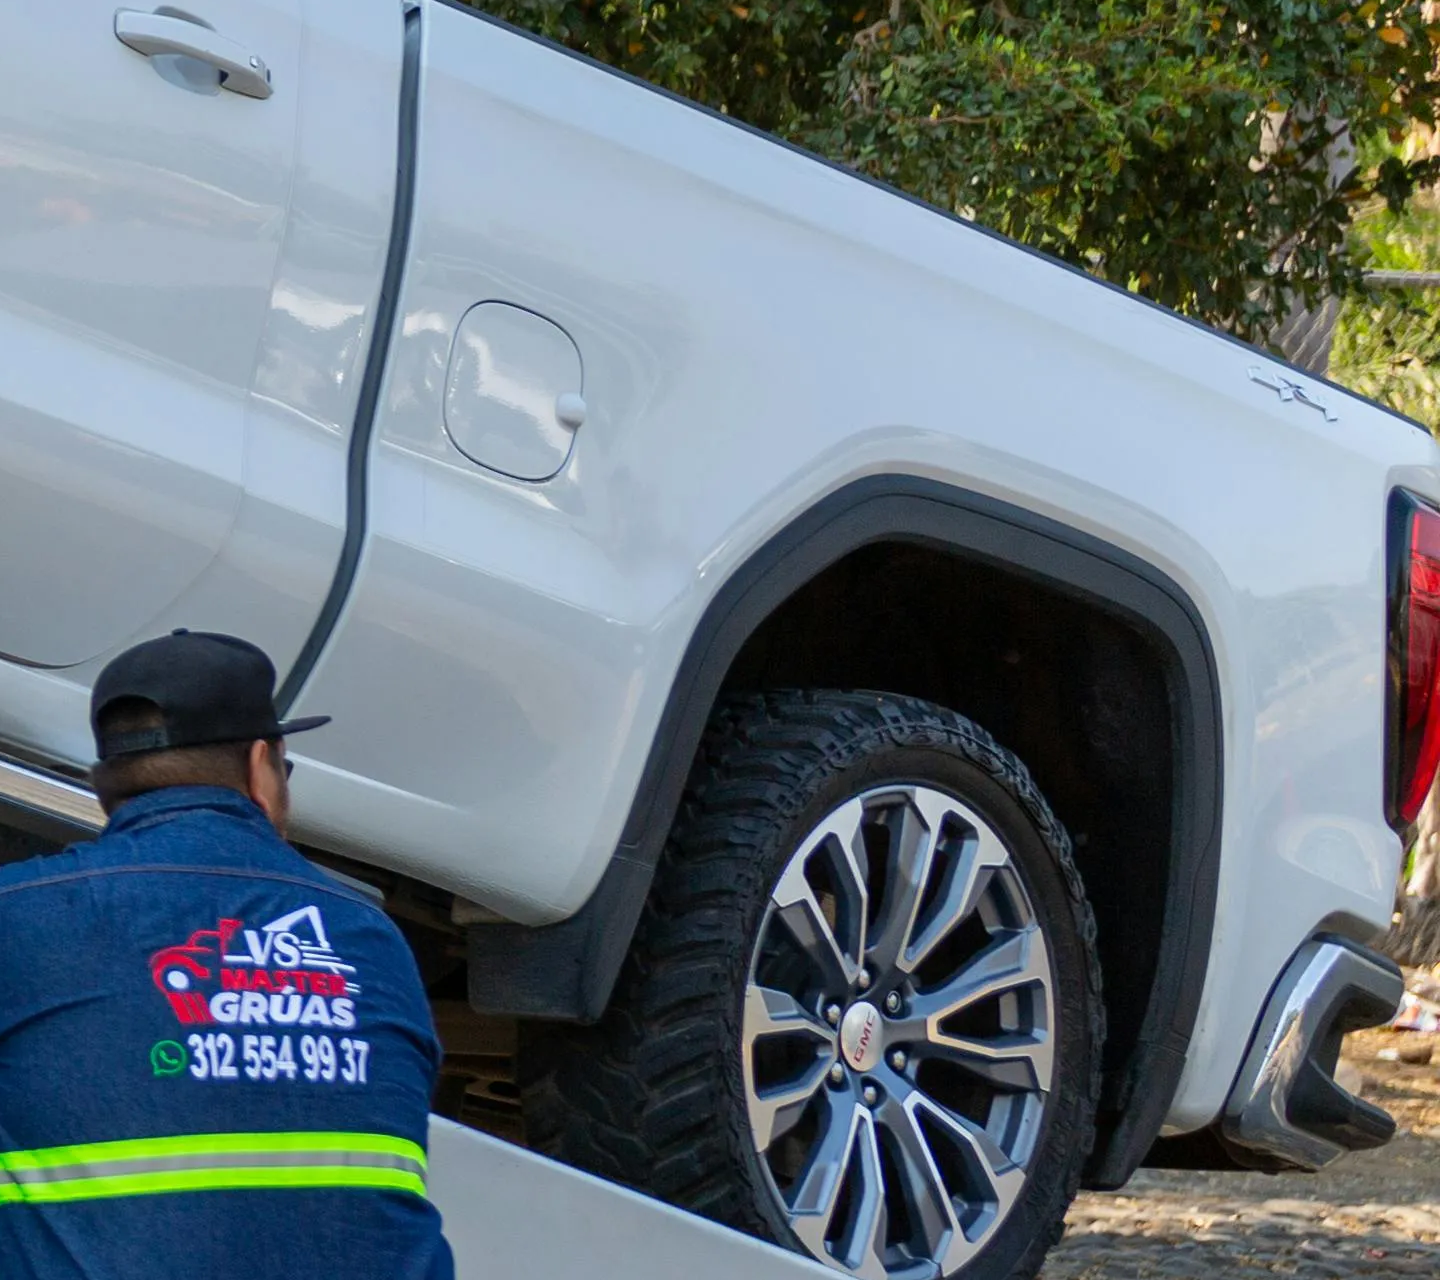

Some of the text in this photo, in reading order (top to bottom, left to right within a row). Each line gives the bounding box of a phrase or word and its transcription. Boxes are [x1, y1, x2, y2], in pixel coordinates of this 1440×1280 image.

[243, 928, 302, 969] VS
[219, 968, 348, 997] MASTER
[208, 986, 358, 1030] GRÚAS
[186, 1032, 371, 1085] 312 554 99 37
[853, 1011, 877, 1064] GMC
